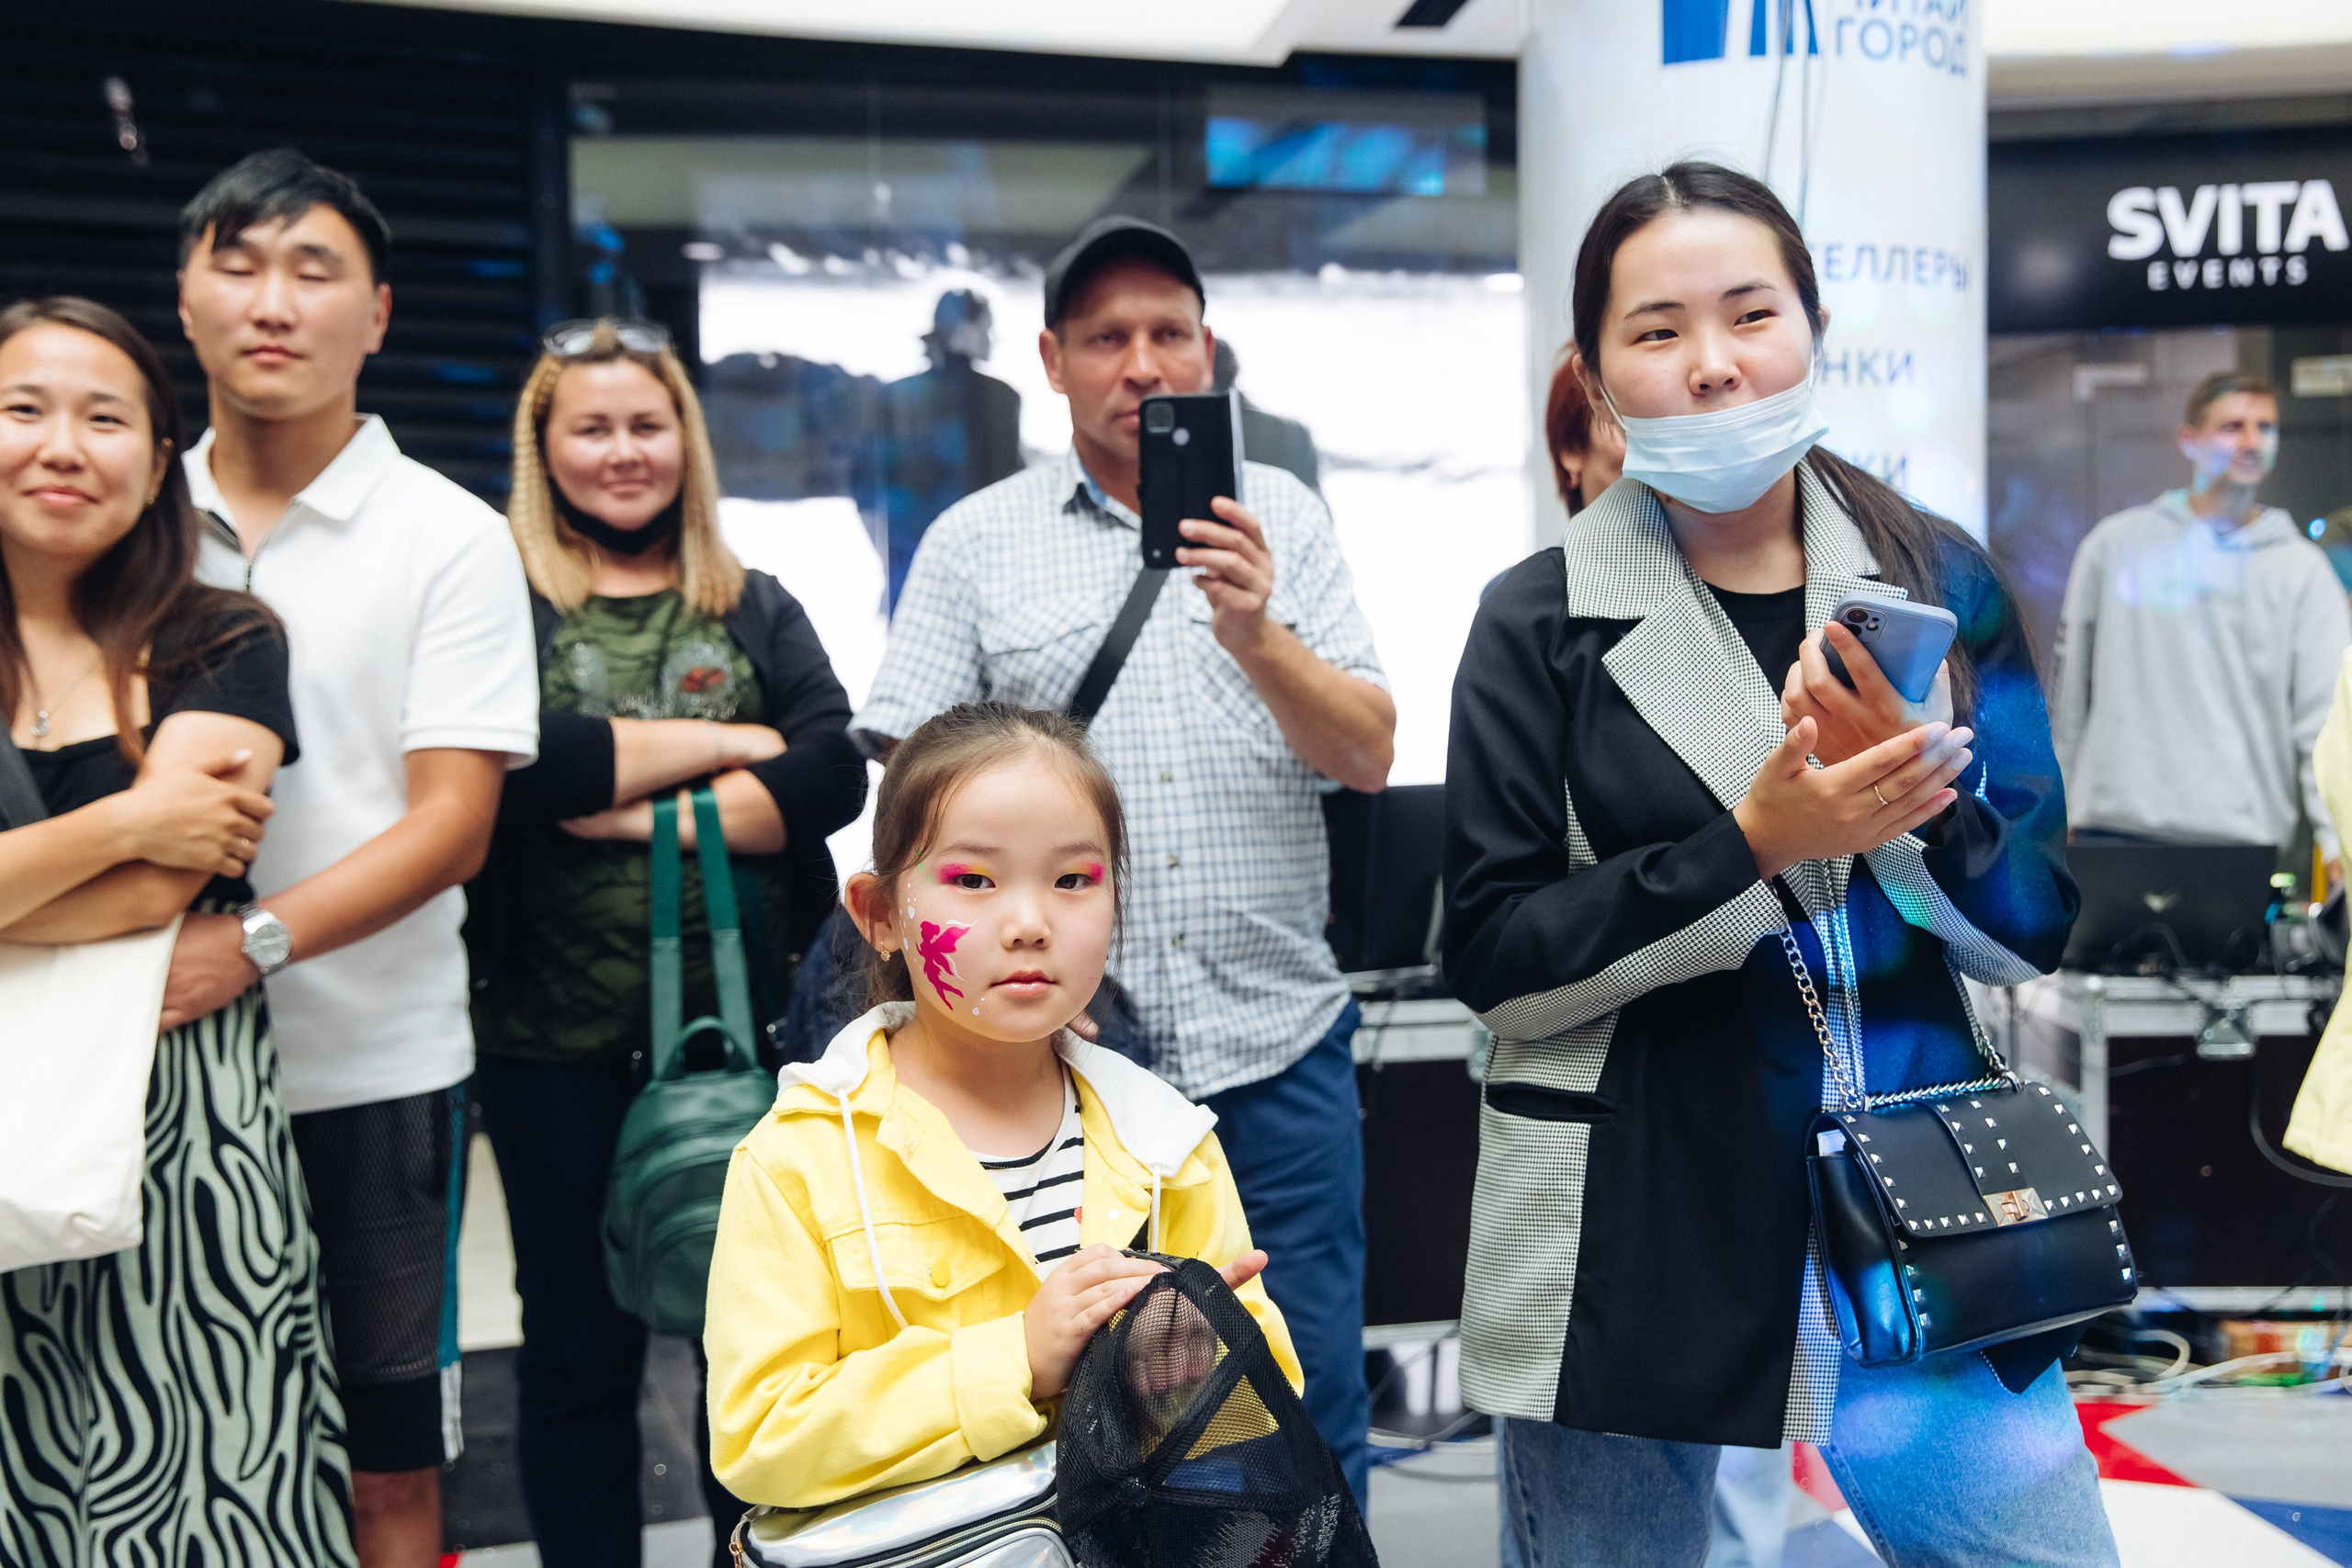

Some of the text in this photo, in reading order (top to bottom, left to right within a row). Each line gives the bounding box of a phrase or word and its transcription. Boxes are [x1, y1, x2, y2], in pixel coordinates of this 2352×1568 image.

[2106, 178, 2350, 261] SVITA
[1807, 241, 1969, 292] ЕЛЛЕРЫ
[2146, 255, 2309, 292] EVENTS
